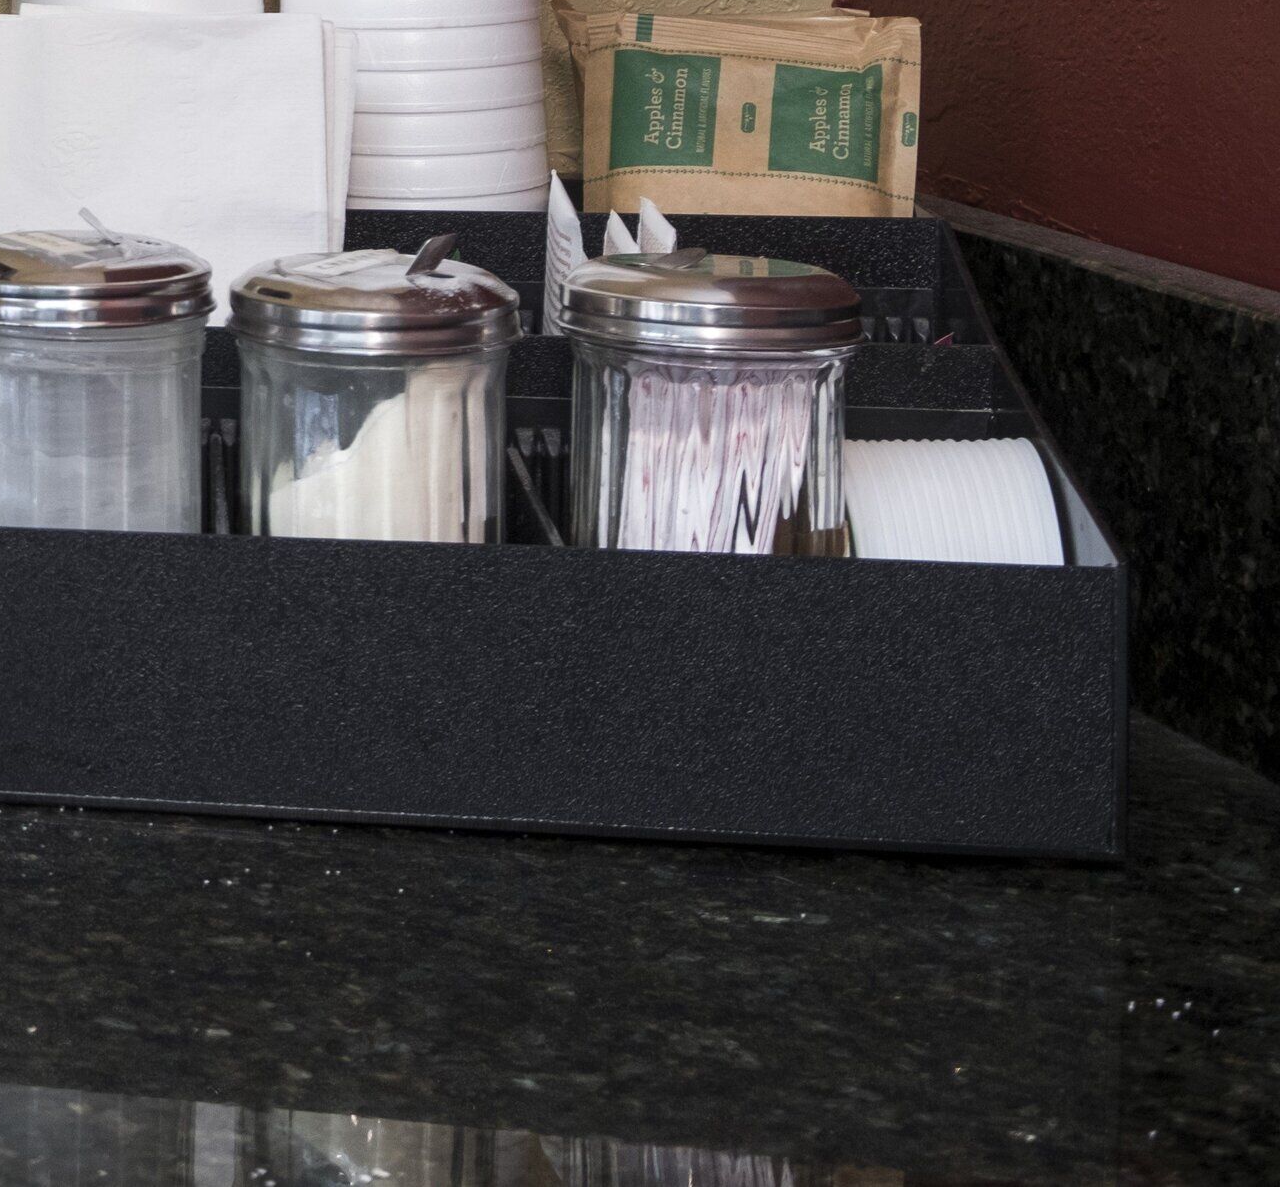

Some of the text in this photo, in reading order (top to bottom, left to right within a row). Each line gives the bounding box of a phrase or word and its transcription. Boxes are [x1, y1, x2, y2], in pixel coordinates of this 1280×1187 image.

[643, 87, 665, 145] Apples
[666, 67, 689, 149] Cinnamon
[809, 99, 831, 153] Apples
[832, 83, 853, 160] Cinnamon
